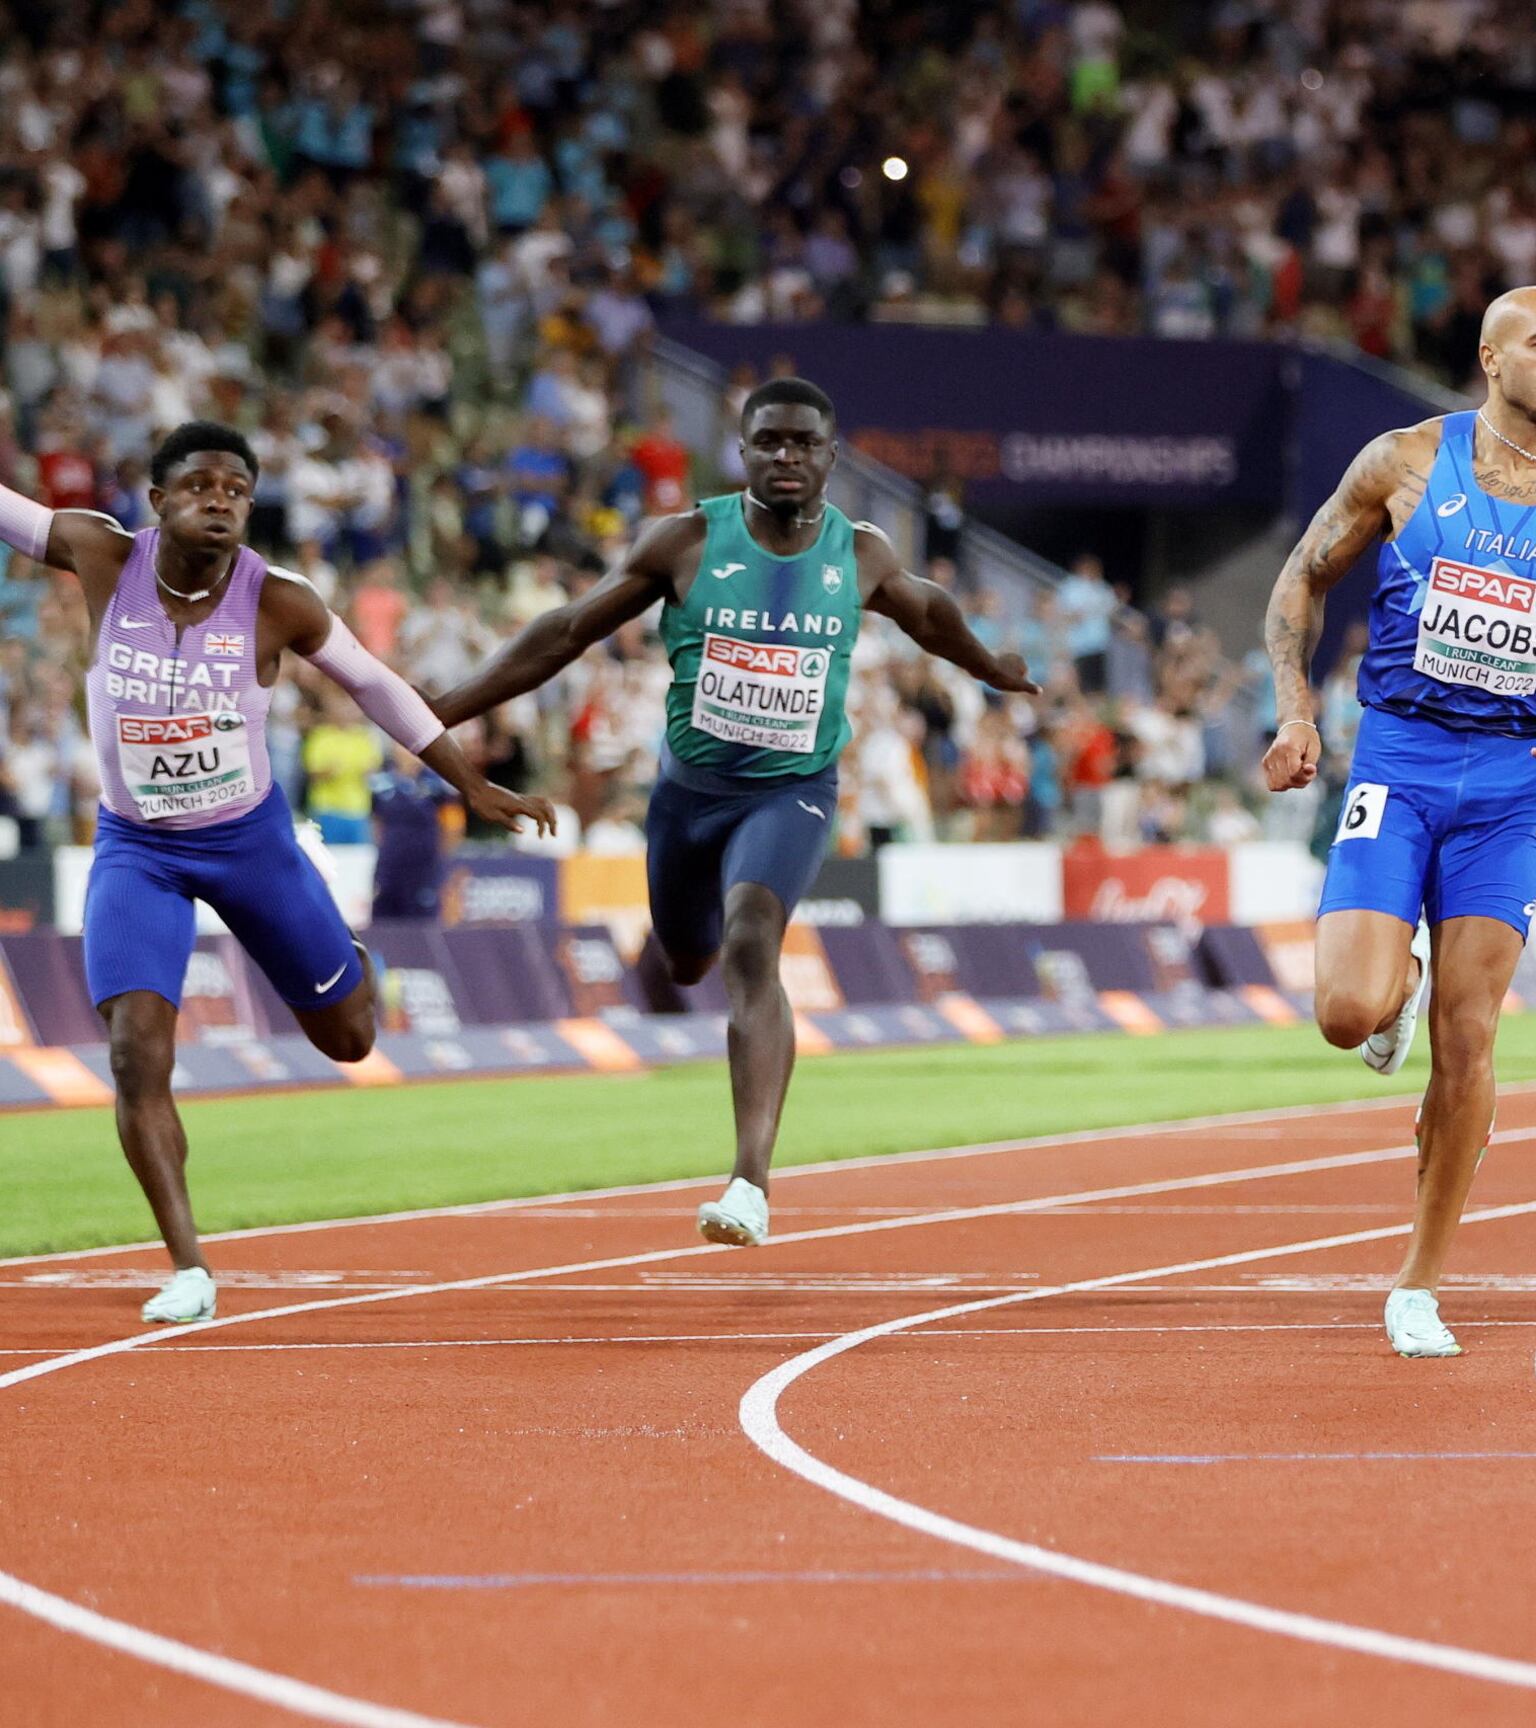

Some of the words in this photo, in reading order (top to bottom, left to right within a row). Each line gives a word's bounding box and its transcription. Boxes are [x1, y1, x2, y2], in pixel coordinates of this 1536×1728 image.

[1435, 566, 1534, 609] SPAR
[704, 606, 843, 636] IRELAND
[108, 642, 240, 687] GREAT
[709, 640, 797, 675] SPAR
[1422, 654, 1490, 684] MUNICH
[1494, 675, 1534, 691] 2022
[1451, 647, 1478, 662] RUN
[1480, 653, 1517, 671] CLEAN
[105, 672, 240, 711] BRITAIN
[701, 671, 819, 715] OLATUNDE
[122, 719, 211, 743] SPAR
[700, 713, 763, 742] MUNICH
[768, 732, 809, 748] 2022
[150, 747, 221, 780] AZU
[139, 795, 203, 814] MUNICH
[208, 780, 247, 803] 2022
[1346, 790, 1369, 830] 6
